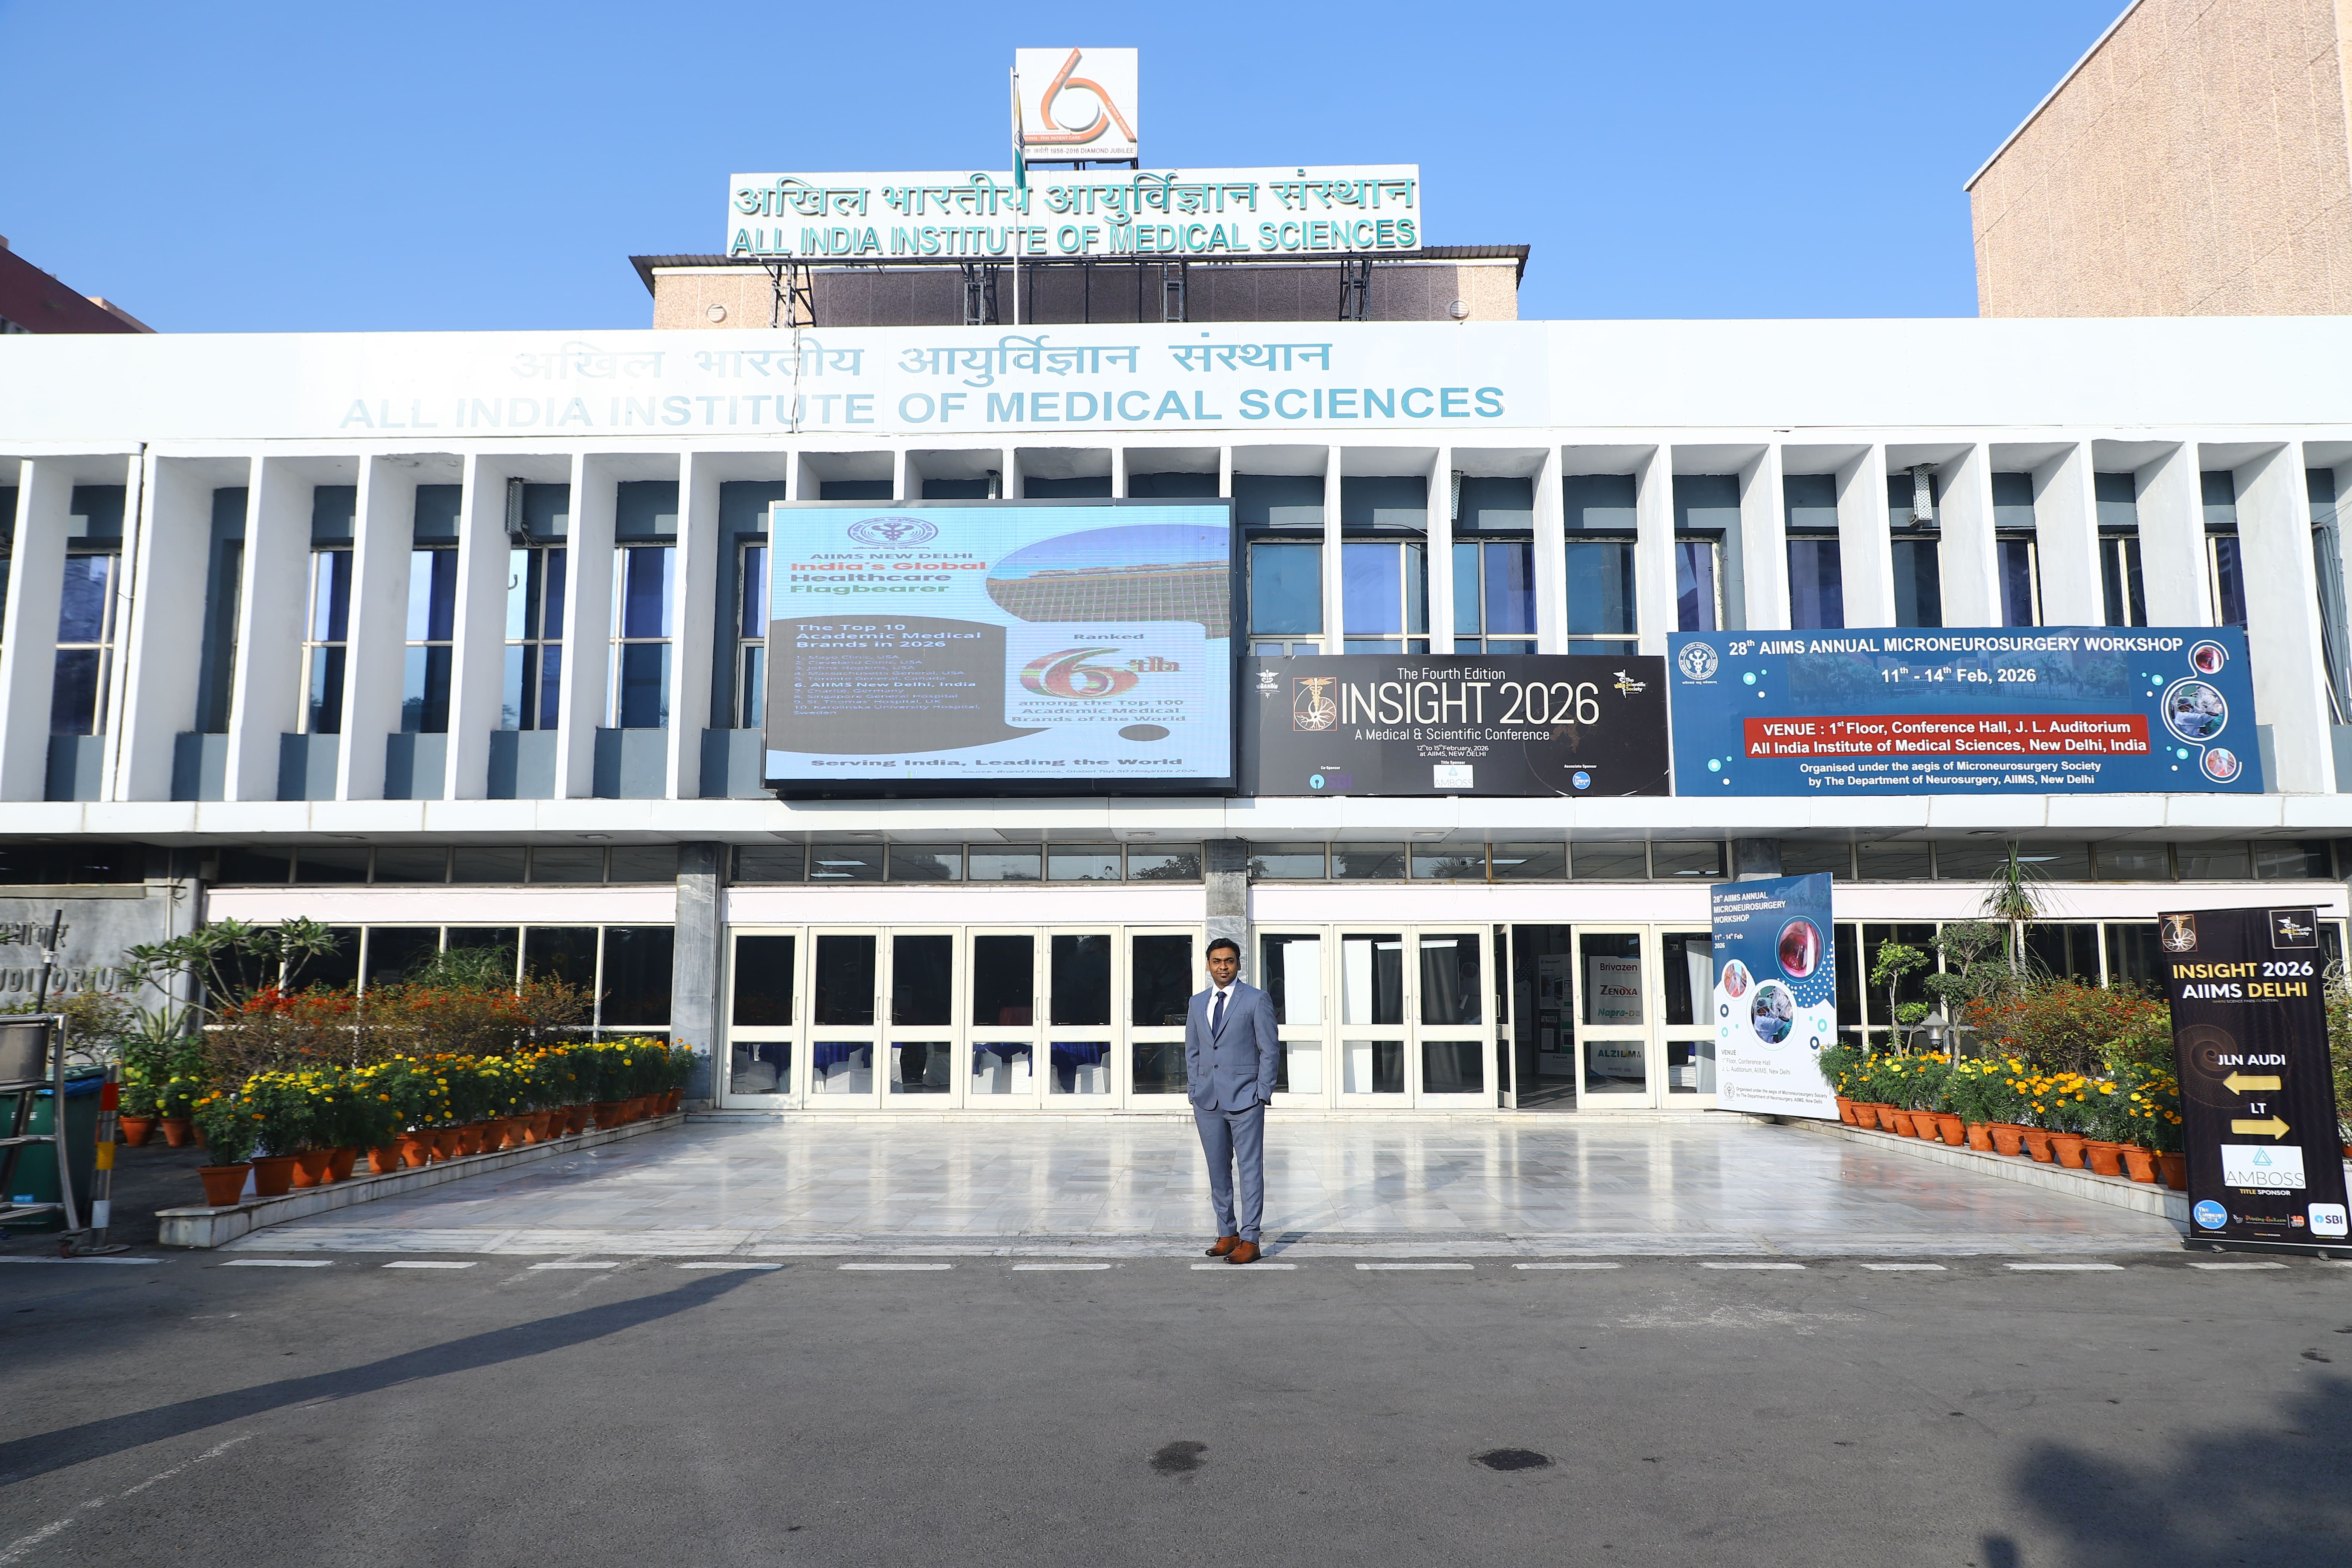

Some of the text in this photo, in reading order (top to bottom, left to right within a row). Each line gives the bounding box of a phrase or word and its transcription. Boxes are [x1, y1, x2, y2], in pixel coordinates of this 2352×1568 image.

[733, 169, 1416, 225] अखिल भारतीय आयुर्विज्ञान संस्थान
[730, 218, 1417, 256] ALL INDIA INSTITUTE OF MEDICAL SCIENCES
[694, 337, 865, 377] भारतीय
[898, 335, 1141, 387] आयुर्विज्ञान
[1168, 332, 1333, 372] संस्थान
[338, 387, 1505, 428] ALL INDIA INSTITUTE OF MEDICAL SCIENCES
[791, 585, 949, 595] Flagbearer
[1729, 637, 2184, 656] 28th AIIMS ANNUAL MICRONEUROSURGERY WORKSHOP
[1397, 668, 1506, 680] The Fourth Edition
[1881, 667, 1909, 683] 11th
[1924, 666, 1952, 683] 14th
[1956, 669, 1992, 684] Feb,
[1997, 668, 2036, 683] 2026
[1342, 681, 1600, 724] INSIGHT 2026
[1355, 728, 1550, 741] A Medical & Scientific Conference
[1763, 720, 2131, 736] VENUE 1st Floor, Conference Hall, J. L. Auditorium
[1750, 739, 2147, 755] All India Institute of Medical Sciences, New Delhi, India
[1800, 761, 2101, 774] Organised under the aegis of Microneurosurgery Society
[1326, 775, 1352, 788] SBI
[1713, 891, 1768, 903] 28th AIIMS ANNUAL
[1713, 900, 1786, 913] MICRONEUROSURGERY
[1713, 914, 1750, 924] WORKSHOP
[2172, 961, 2314, 979] INSIGHT 2026
[2182, 982, 2308, 999] AIIMS DELHI
[1598, 1008, 1635, 1018] Napra-D
[2218, 1054, 2286, 1066] JLN AUDI
[2250, 1103, 2266, 1114] LT
[2225, 1171, 2305, 1187] AMBOSS
[2325, 1216, 2343, 1224] SBI
